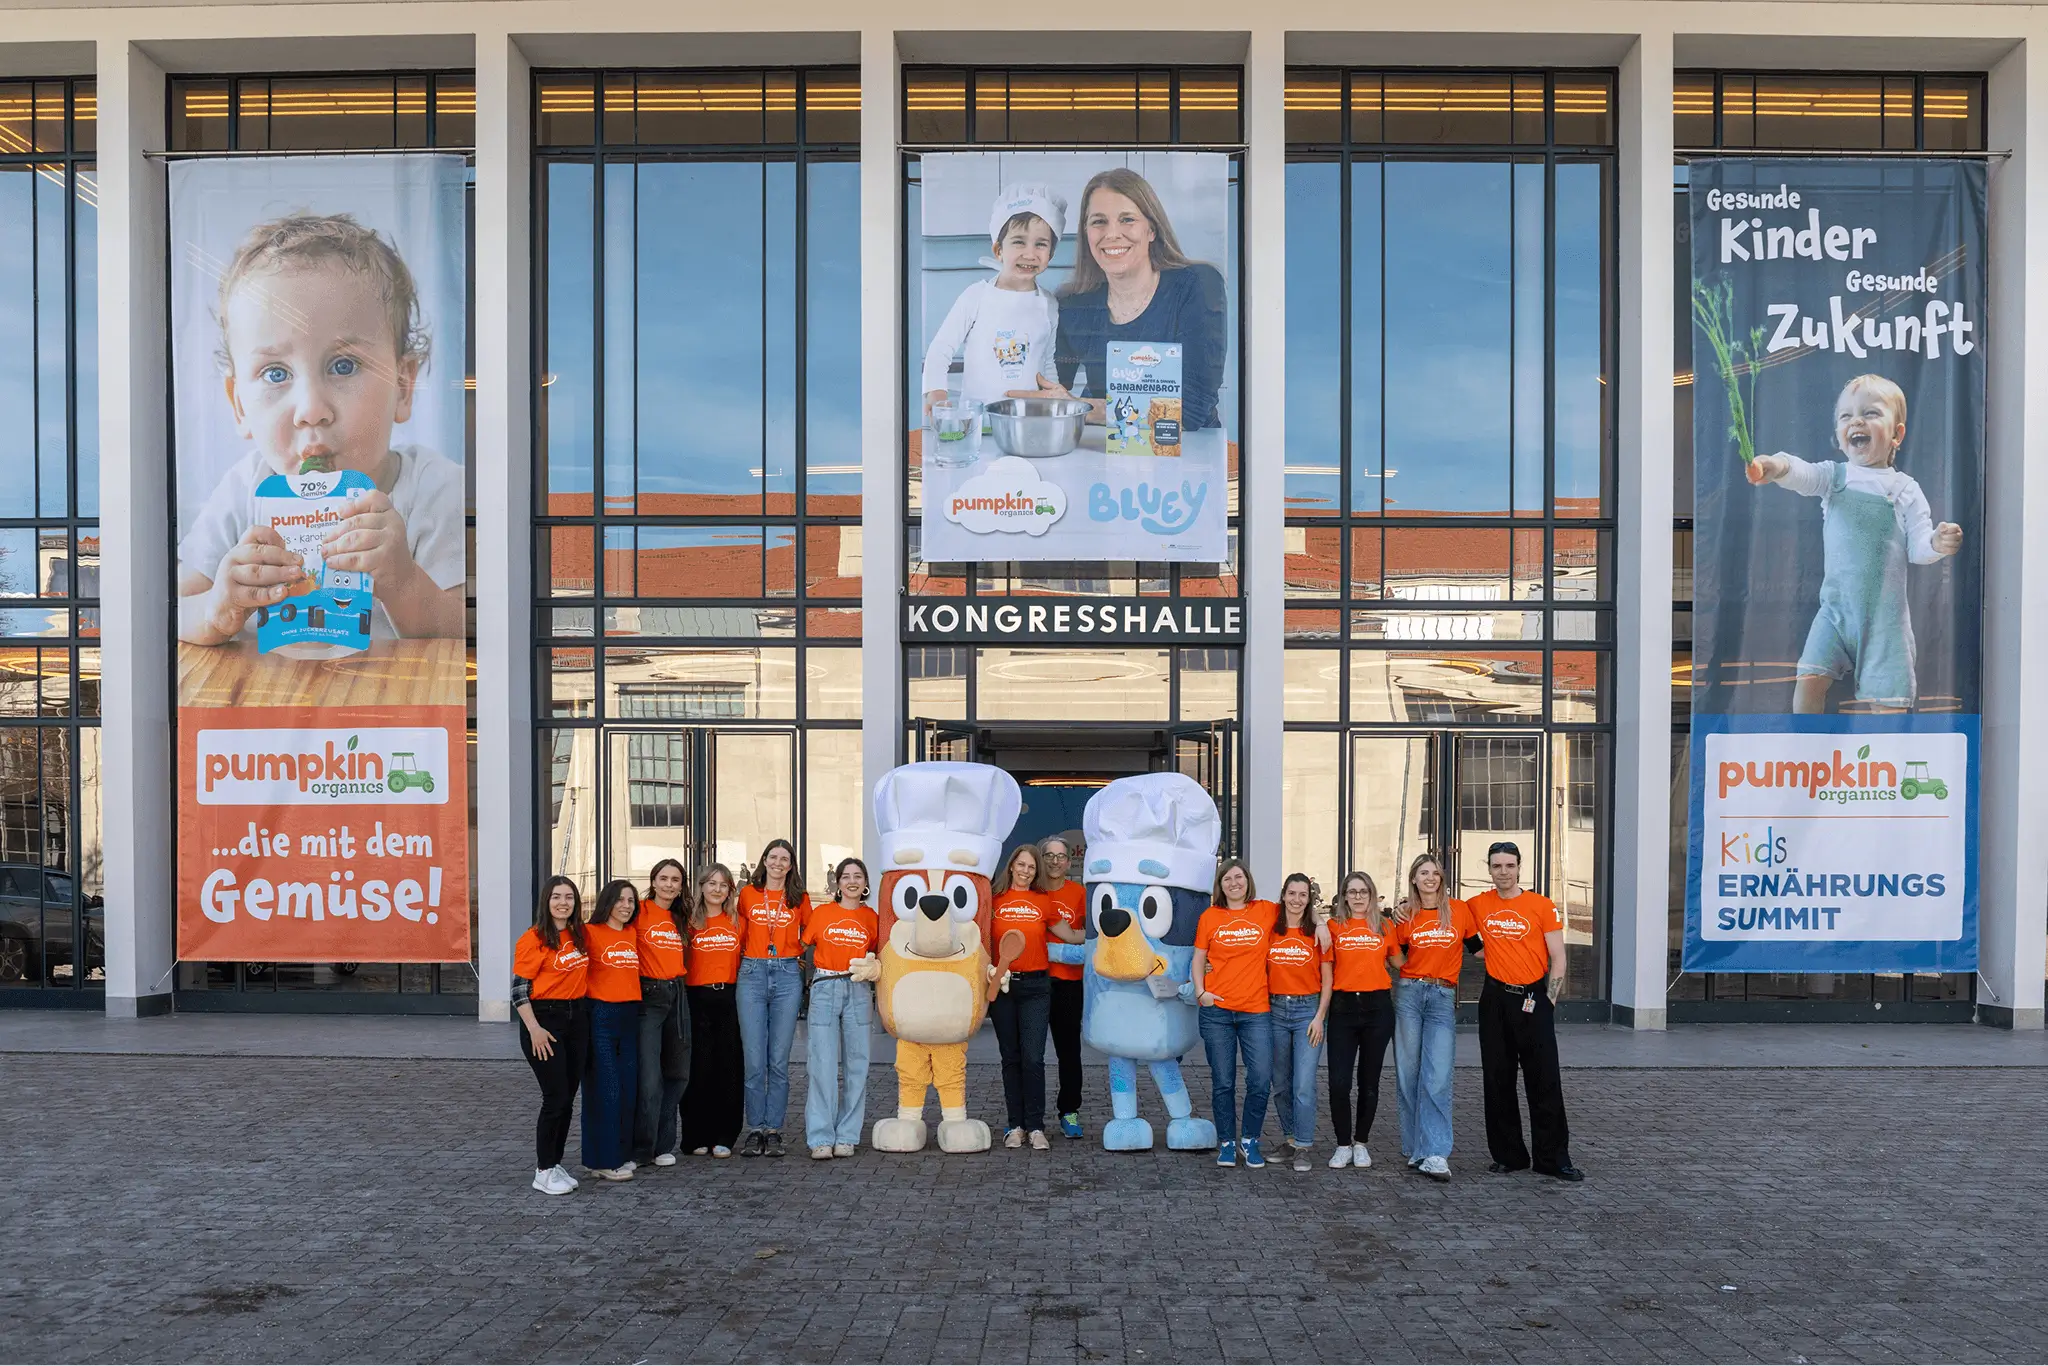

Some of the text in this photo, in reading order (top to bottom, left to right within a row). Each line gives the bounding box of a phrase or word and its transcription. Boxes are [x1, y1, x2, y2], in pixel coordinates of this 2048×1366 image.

[1707, 184, 1800, 211] Gesunde
[1721, 208, 1877, 263] Kinder
[1846, 267, 1938, 293] Gesunde
[1767, 296, 1974, 360] Zukunft
[300, 481, 327, 492] 70%
[300, 490, 327, 498] Gemüse
[952, 490, 1033, 515] pumpkin
[999, 508, 1034, 517] organics
[1088, 480, 1207, 535] BLUEY
[271, 507, 339, 529] pumpkin
[908, 605, 1241, 634] KONGRESSHALLE
[205, 735, 383, 792] pumpkin
[1719, 744, 1897, 799] pumpkin
[311, 781, 384, 798] organics
[1819, 790, 1896, 804] organics
[212, 821, 432, 859] ...die mit dem
[1721, 826, 1787, 867] Kids
[1718, 868, 1946, 897] ERNÄHRUNGS
[200, 866, 442, 925] Gemüse!
[1487, 918, 1517, 928] pumpkin
[1718, 907, 1841, 930] SUMMIT
[696, 933, 728, 944] pumpkin
[828, 927, 860, 937] pumpkin
[1218, 927, 1251, 938] pumpkin
[1339, 934, 1371, 943] pumpkin
[1269, 945, 1302, 955] pumpkin
